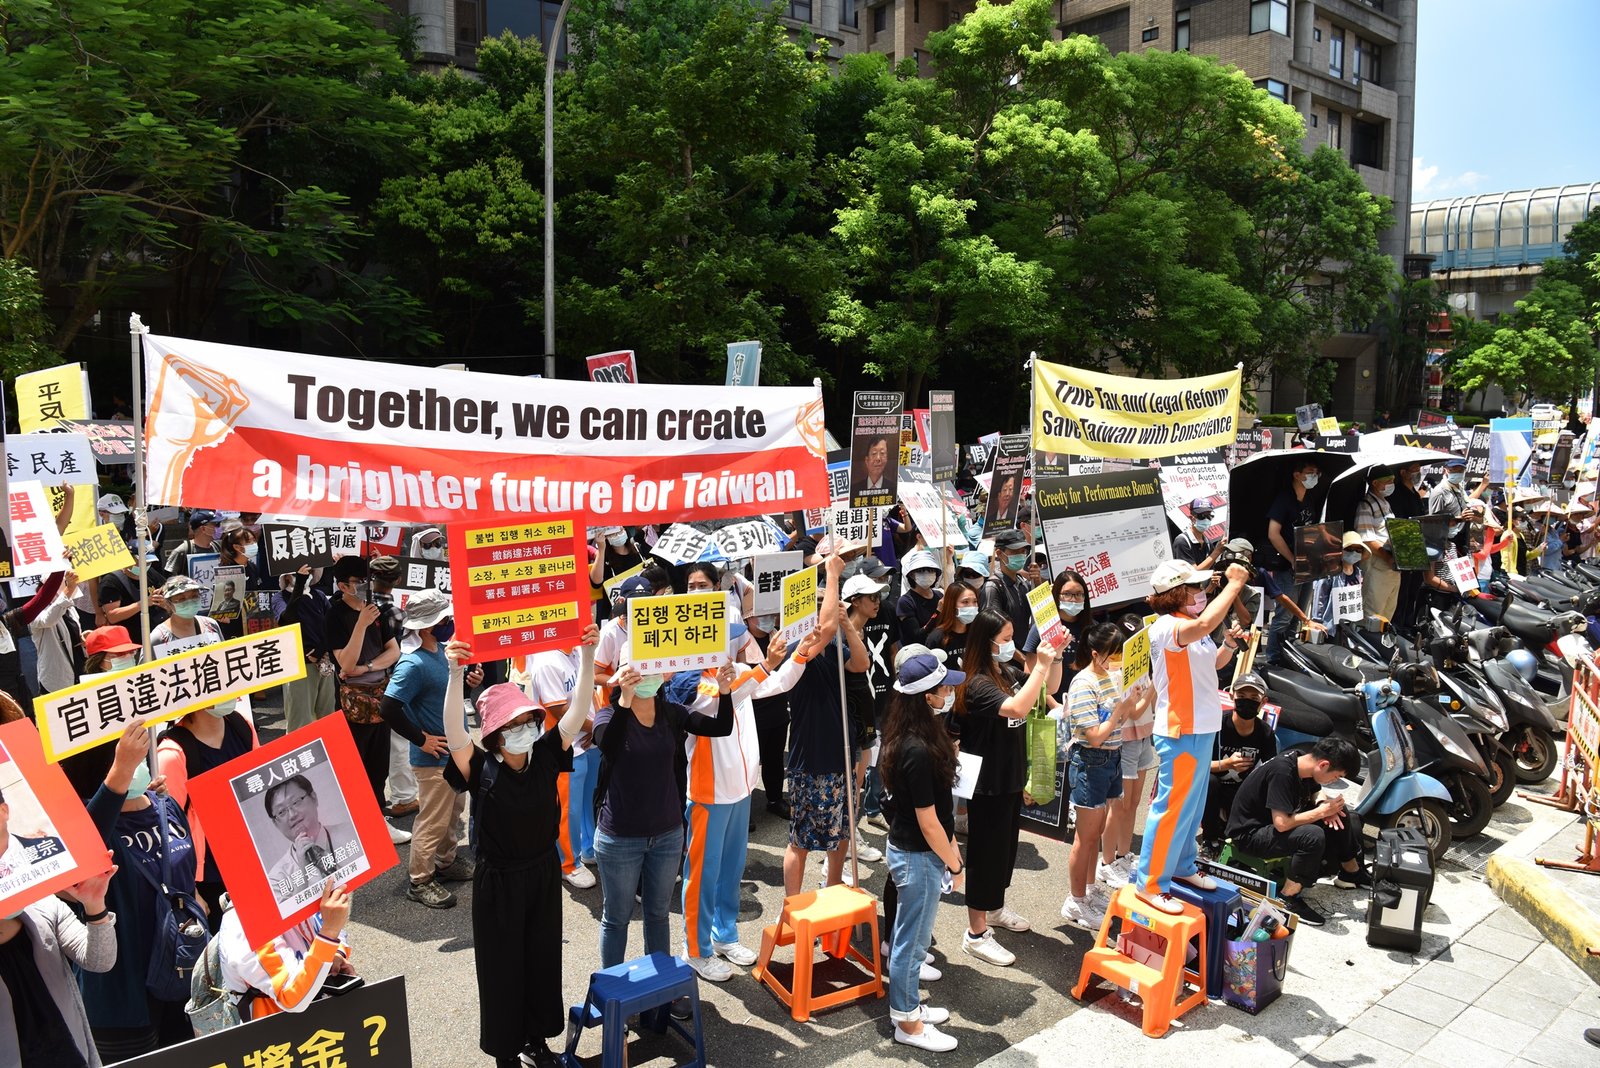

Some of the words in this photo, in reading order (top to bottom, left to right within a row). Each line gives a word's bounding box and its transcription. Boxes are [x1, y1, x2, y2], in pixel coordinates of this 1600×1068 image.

[287, 374, 503, 440] Together,
[512, 402, 570, 439] we
[580, 406, 648, 441] can
[657, 405, 767, 441] create
[1055, 380, 1094, 408] True
[1094, 386, 1122, 411] Tax
[1123, 392, 1148, 413] and
[1150, 391, 1183, 415] Legal
[1185, 387, 1229, 411] Reform
[1042, 410, 1082, 439] Save
[1079, 418, 1138, 444] Taiwan
[1138, 424, 1170, 445] with
[1170, 415, 1232, 444] Conscience
[1326, 437, 1346, 448] Largest
[1174, 455, 1209, 465] Agency
[1177, 465, 1217, 474] Conducted
[252, 458, 282, 498] a
[295, 454, 482, 511] brighter
[490, 472, 612, 514] future
[621, 474, 676, 512] for
[682, 468, 803, 508] Taiwan.
[1170, 475, 1195, 483] Illegal
[1039, 489, 1068, 508] Greedy
[1069, 488, 1081, 503] for
[1083, 482, 1132, 501] Performance
[1132, 479, 1153, 495] Bonus
[1154, 477, 1160, 495] ?
[271, 526, 327, 561] 反貪污
[475, 532, 494, 544] 불법
[499, 530, 519, 541] 집행
[523, 527, 543, 539] 취소
[547, 525, 566, 536] 하라
[515, 566, 533, 577] 소장
[758, 569, 800, 593] 告到
[485, 587, 506, 600] 署長
[511, 583, 541, 596] 副署長
[546, 580, 565, 591] 下台
[482, 617, 511, 629] 끝까지
[516, 613, 535, 624] 고소
[539, 607, 567, 620] 할거다
[634, 605, 669, 626] 집행
[675, 601, 726, 623] 장려금
[498, 627, 557, 645] 告到底
[643, 628, 677, 648] 폐지
[684, 624, 719, 645] 하라
[57, 638, 284, 742] 官員違法搶民產
[245, 749, 316, 793] 尋人啟事
[278, 863, 319, 896] 副署長
[321, 839, 360, 871] 陳盈錦
[295, 862, 358, 905] 法務部行執行署
